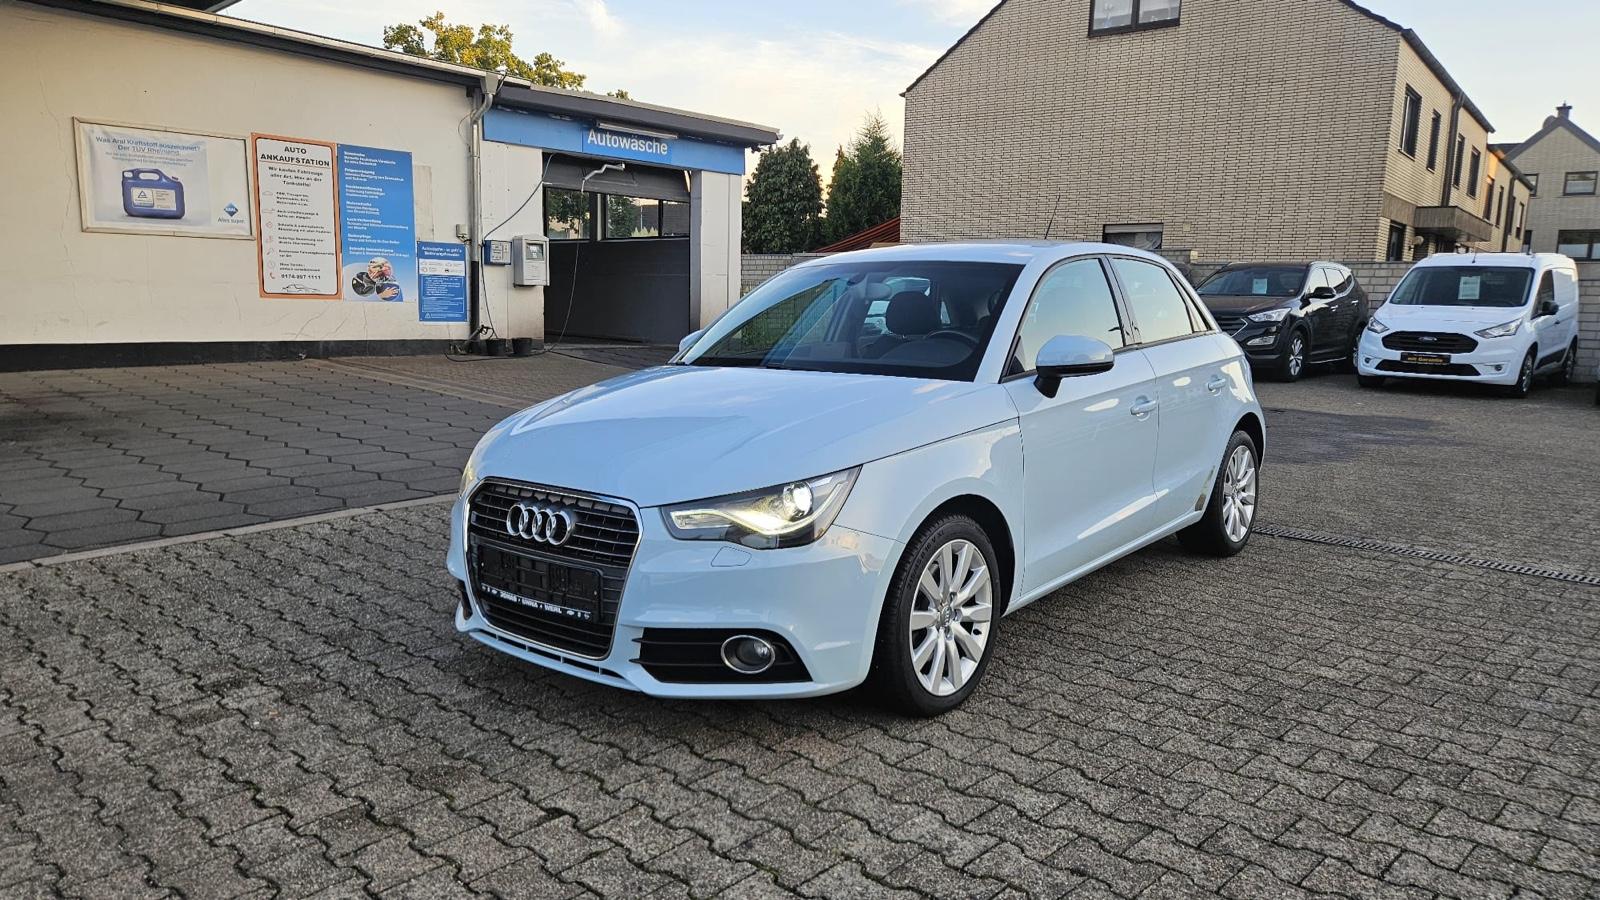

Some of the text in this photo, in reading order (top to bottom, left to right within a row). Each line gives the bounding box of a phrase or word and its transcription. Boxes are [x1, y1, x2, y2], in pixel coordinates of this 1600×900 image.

[587, 128, 668, 155] Autowäsche
[284, 146, 306, 154] AUTO
[260, 154, 330, 166] ANKAUFSTATION
